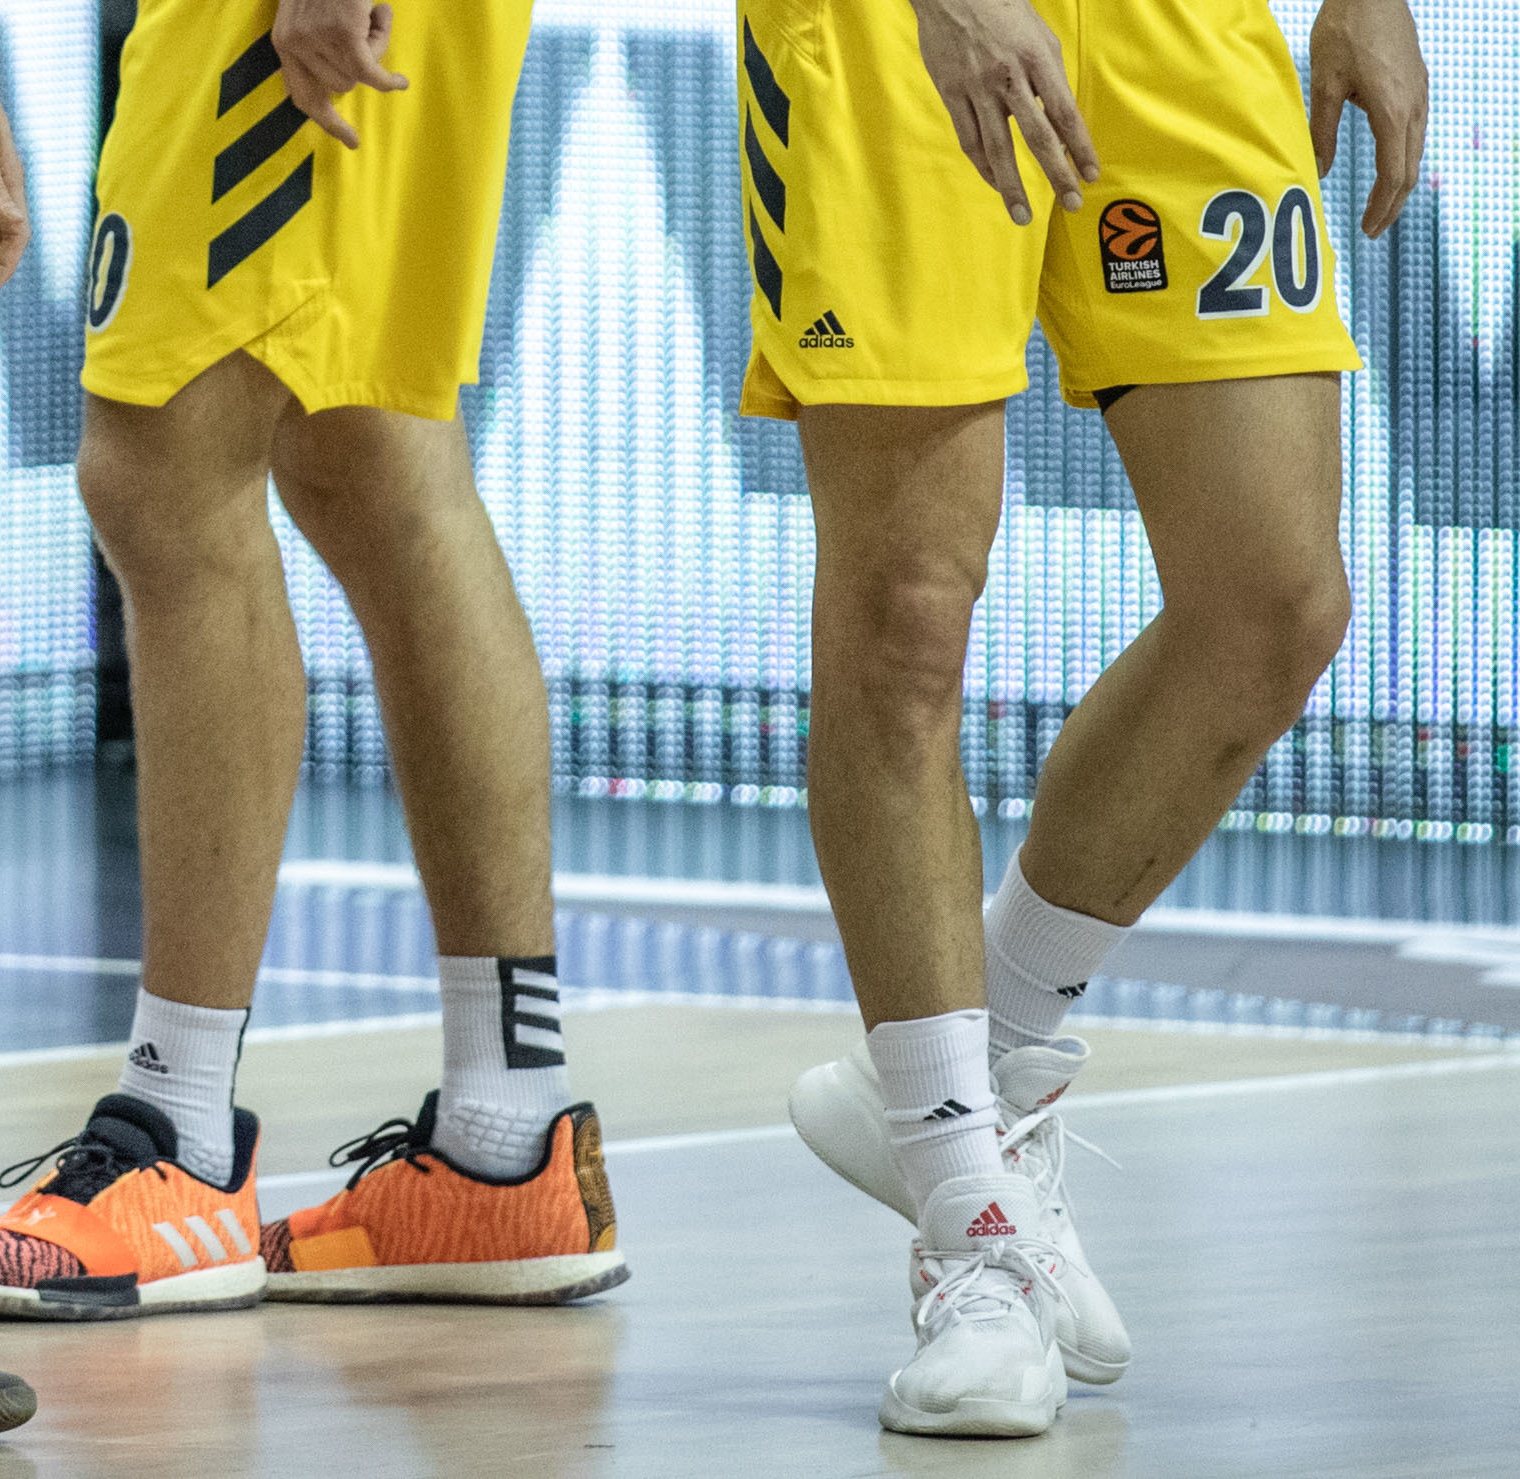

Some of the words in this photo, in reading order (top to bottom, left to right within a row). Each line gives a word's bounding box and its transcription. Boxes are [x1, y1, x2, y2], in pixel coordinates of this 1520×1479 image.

[1196, 186, 1323, 320] 20
[1108, 259, 1160, 271] TURKISH
[1110, 269, 1161, 281] AIRLINES
[1110, 279, 1162, 289] EuroLeague
[798, 333, 855, 349] adidas
[966, 1224, 1017, 1238] adidas
